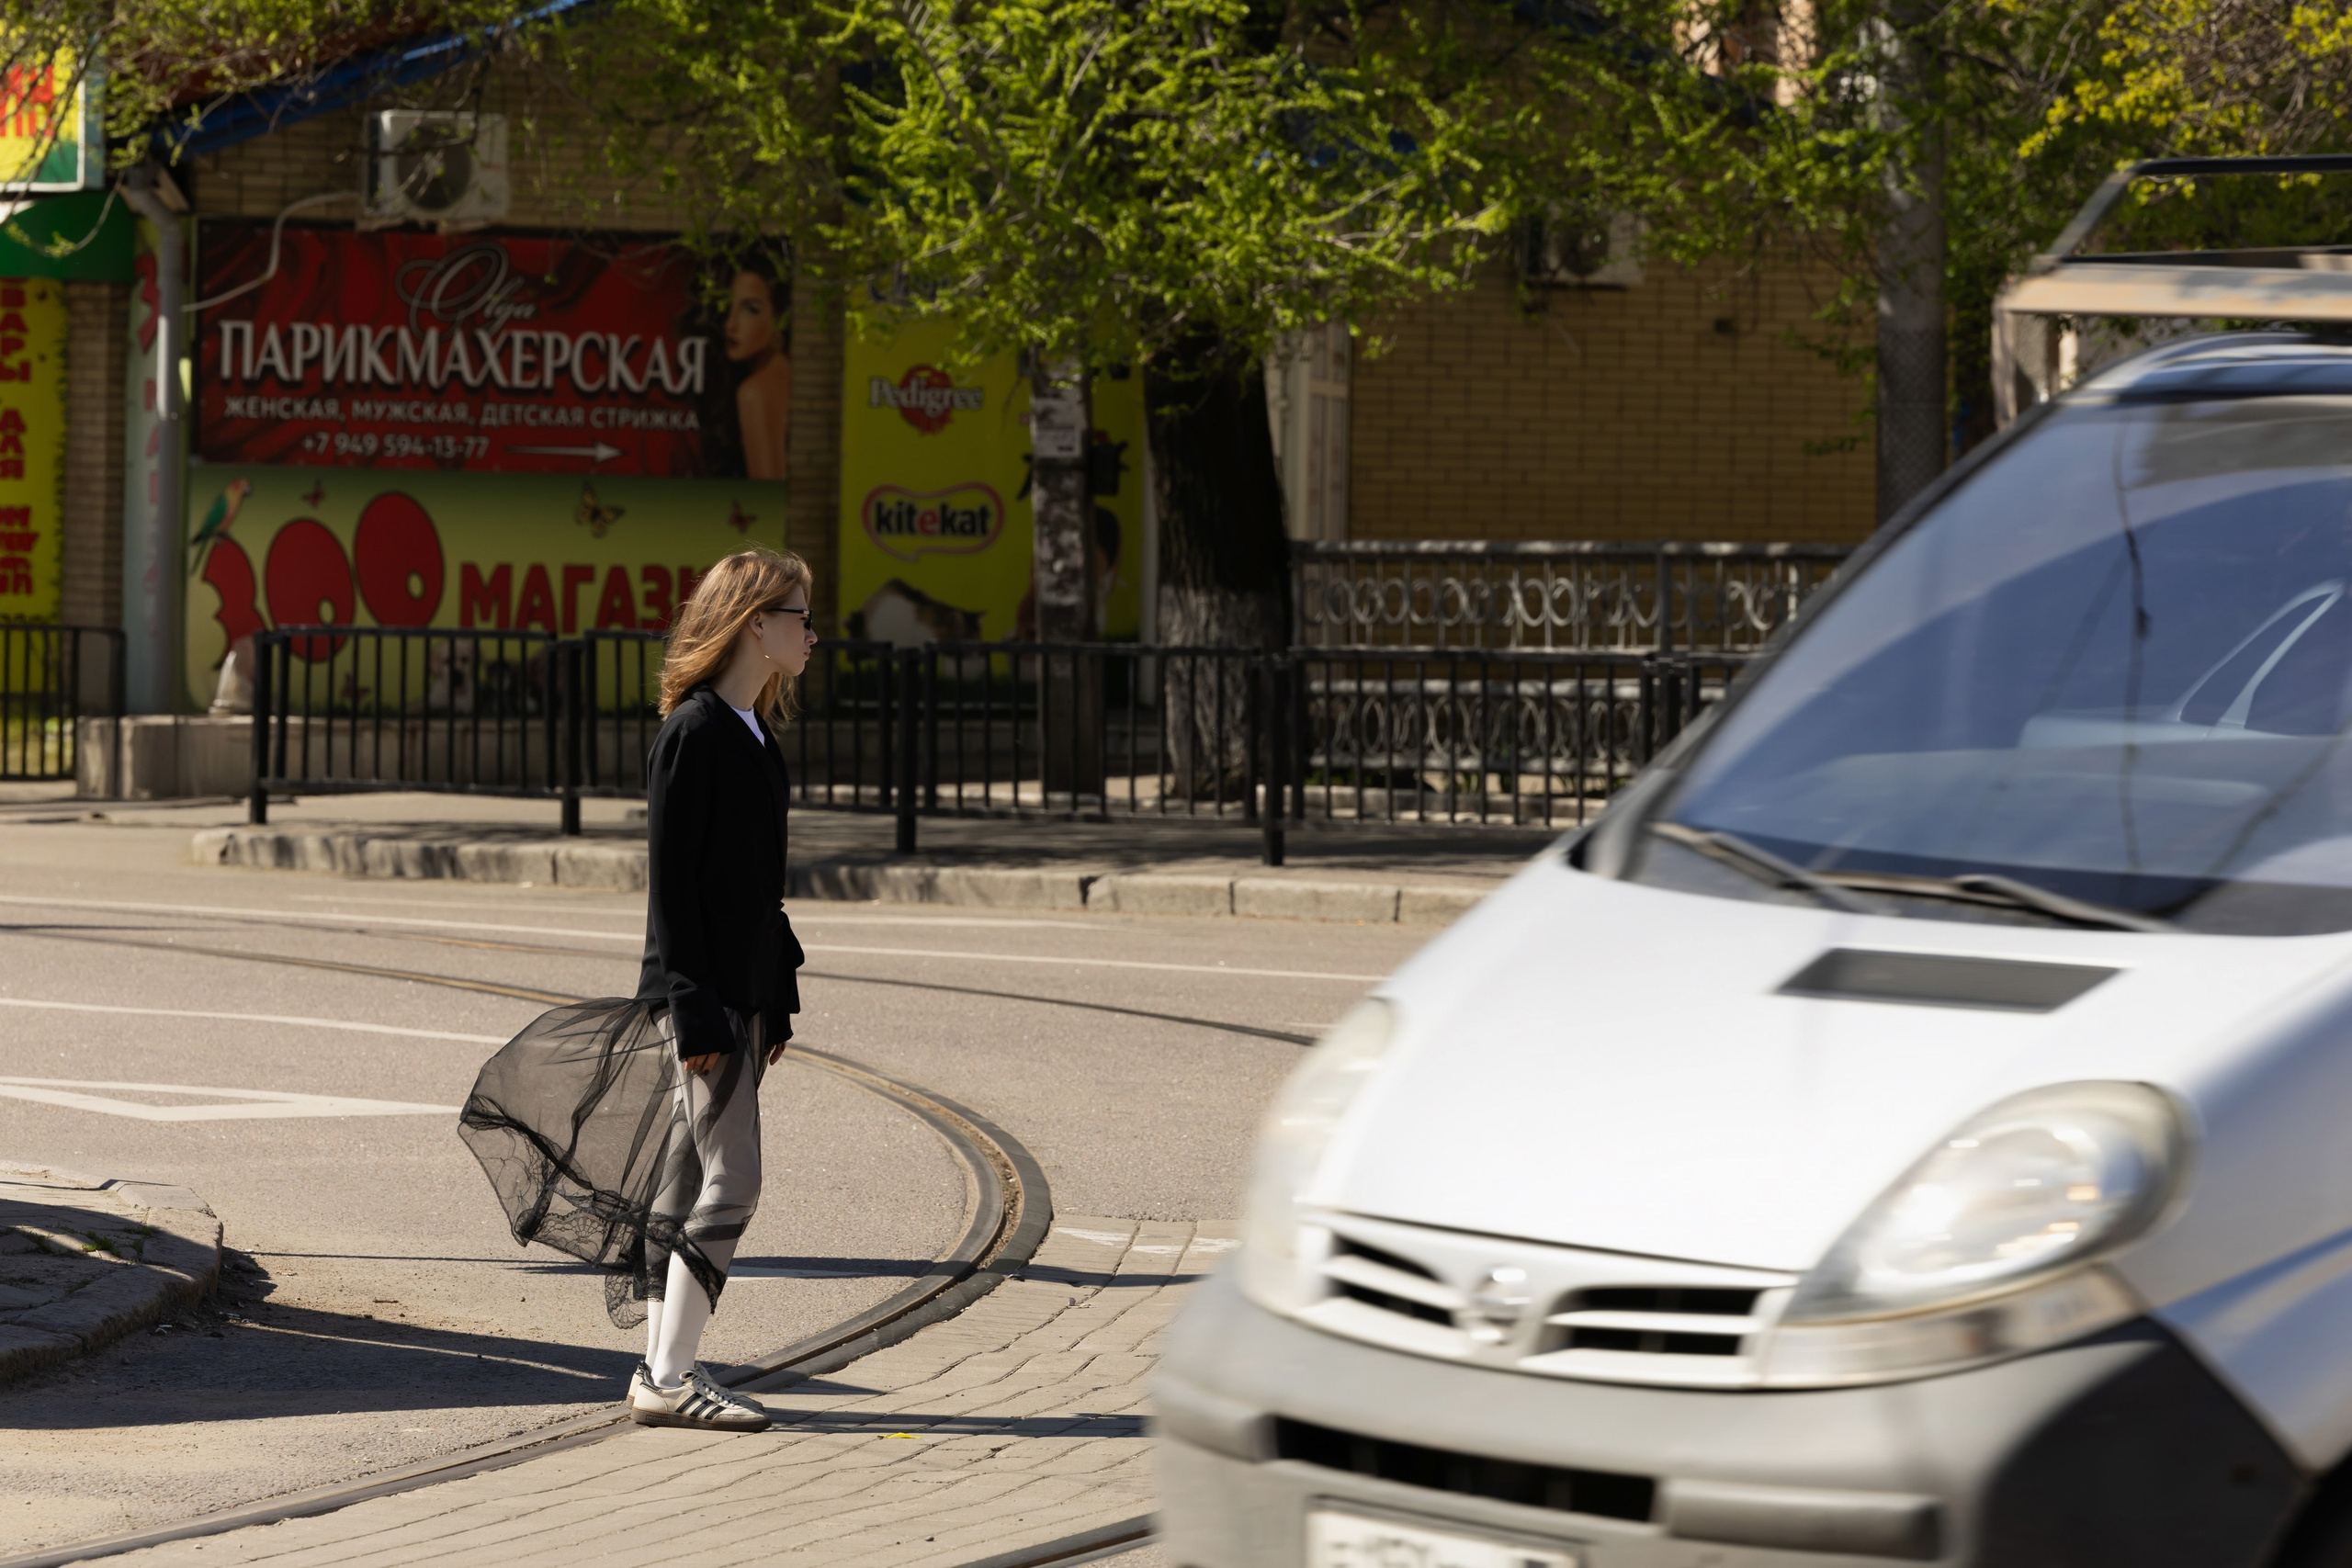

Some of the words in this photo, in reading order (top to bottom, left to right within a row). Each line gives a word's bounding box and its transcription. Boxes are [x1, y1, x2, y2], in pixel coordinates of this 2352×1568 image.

[218, 320, 709, 395] ПАРИКМАХЕРСКАЯ
[223, 396, 346, 423] ЖЕНСКАЯ,
[351, 399, 476, 426] МУЖСКАЯ,
[480, 402, 585, 428] ДЕТСКАЯ
[590, 406, 700, 431] СТРИЖКА
[868, 377, 983, 416] Pedigree
[301, 432, 330, 456] +7
[334, 432, 379, 457] 949
[383, 434, 491, 460] 594-13-77
[876, 501, 990, 536] kitekat
